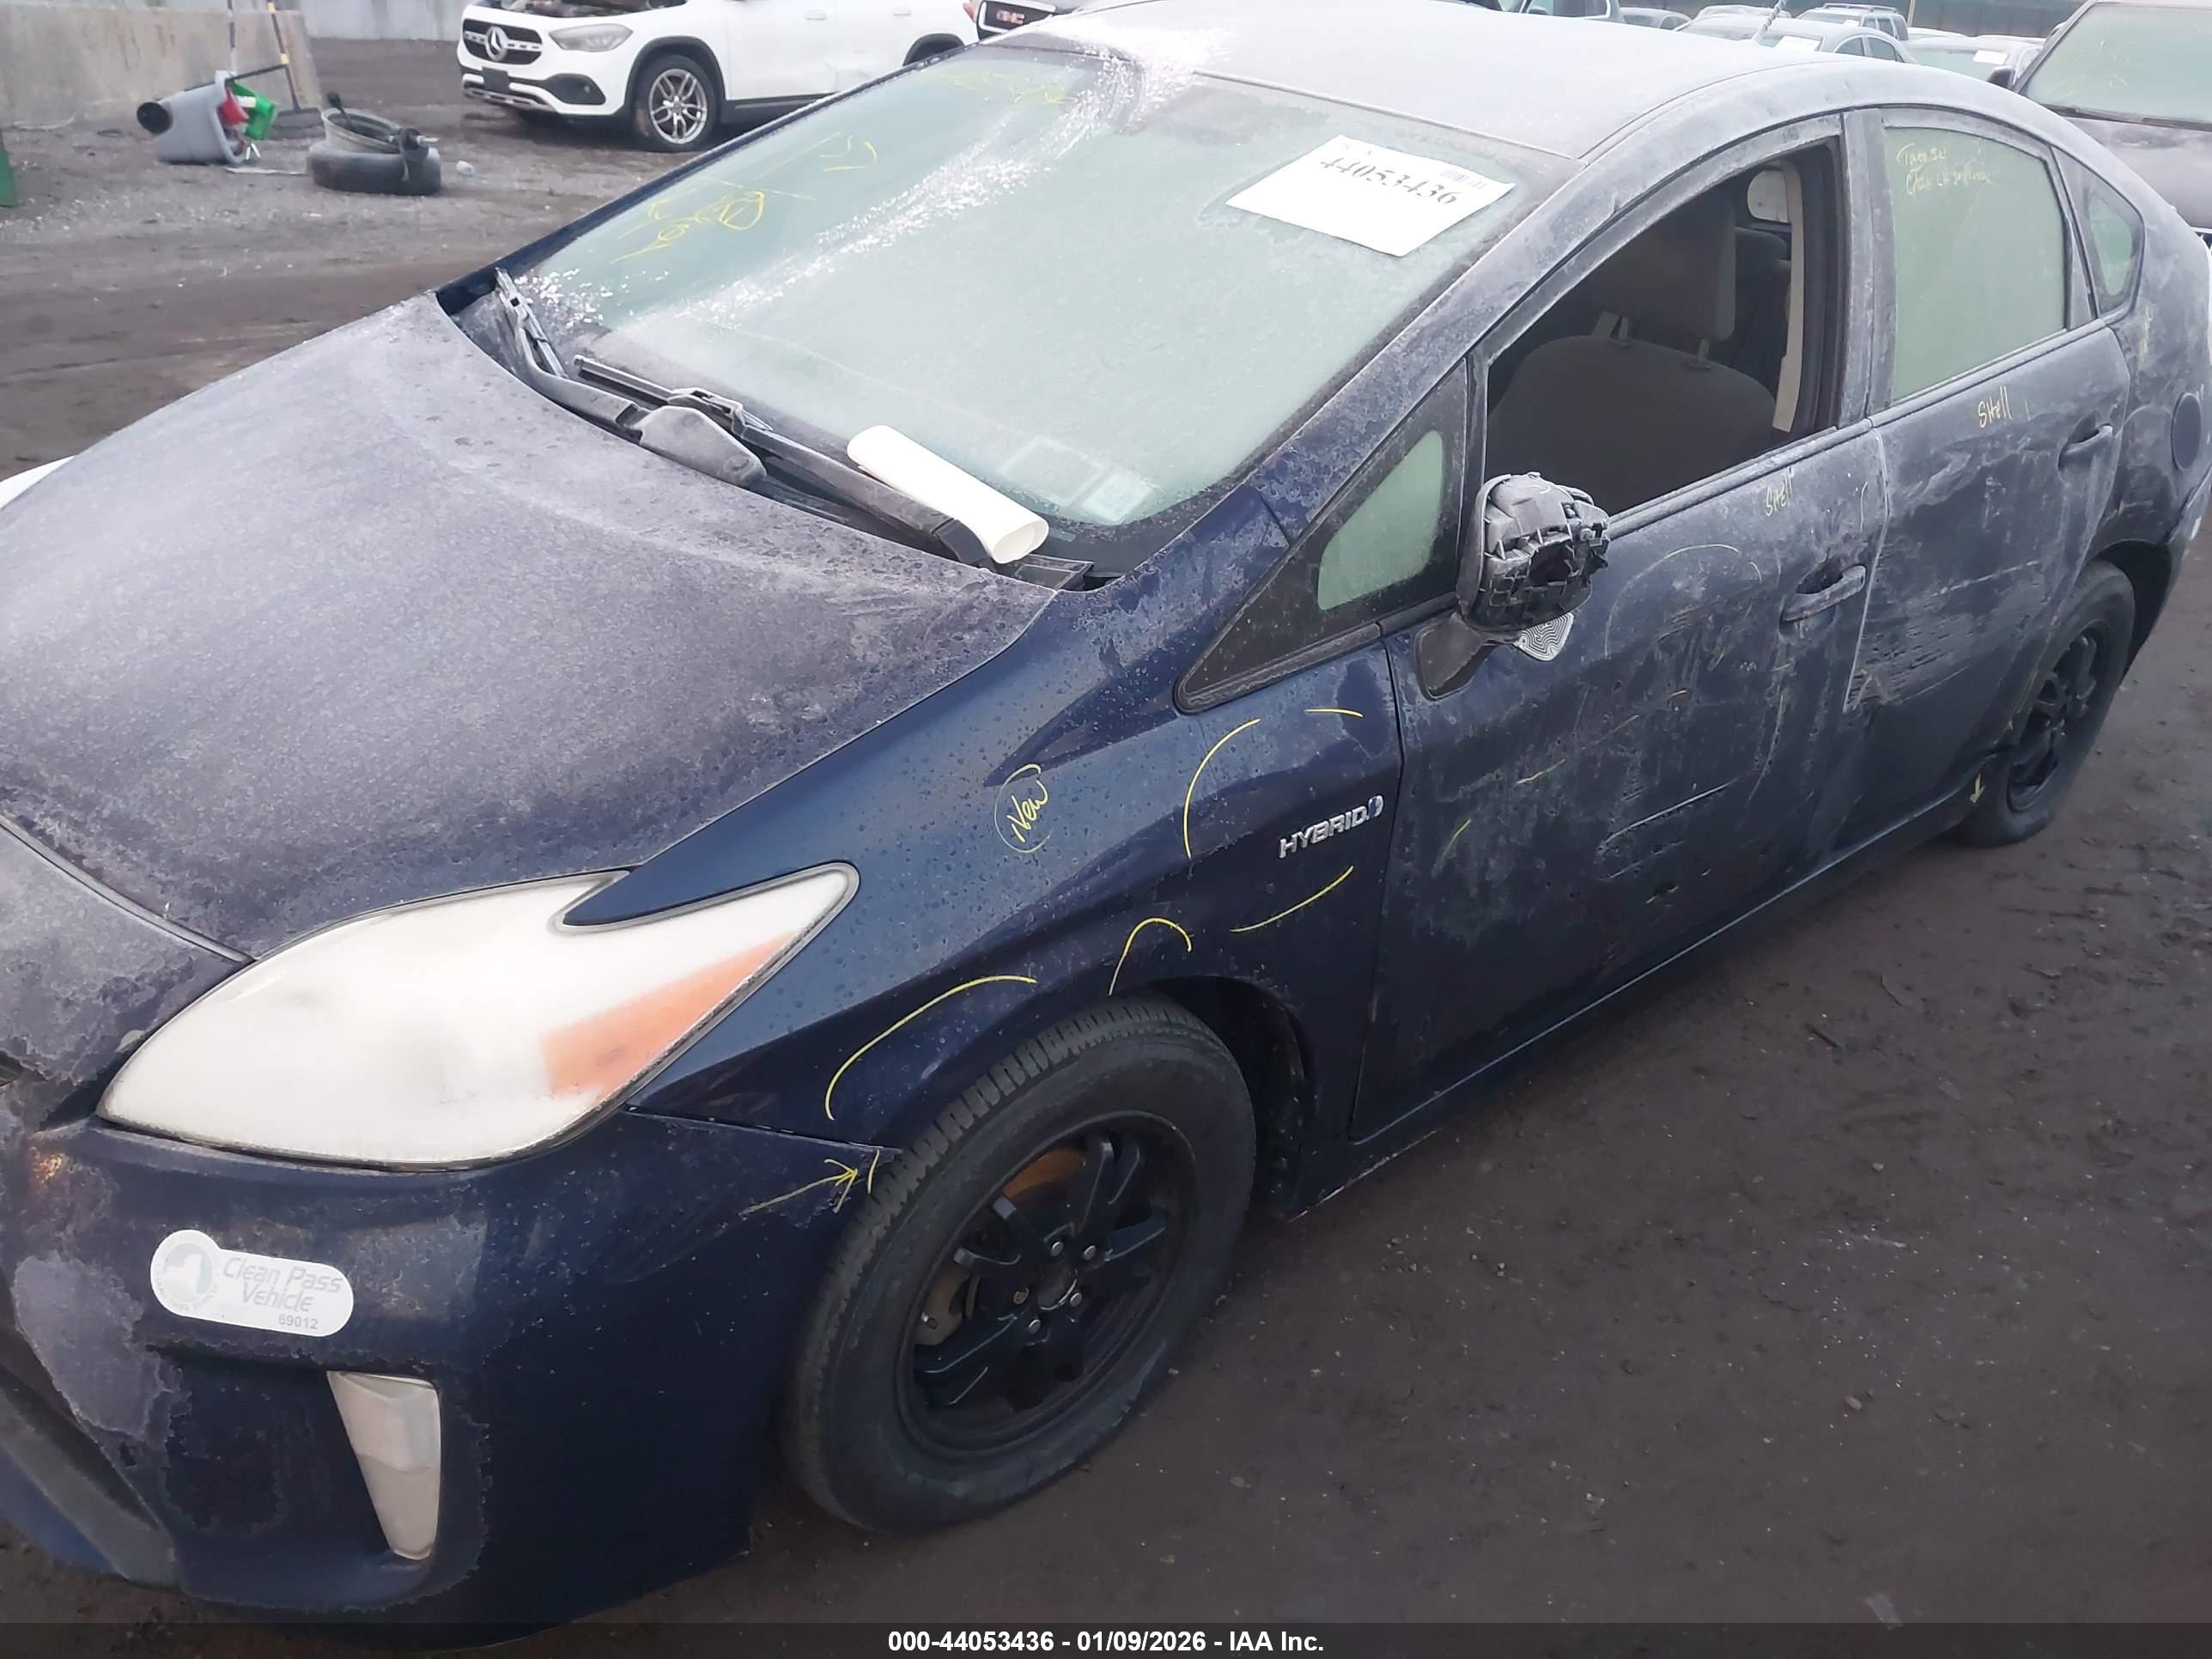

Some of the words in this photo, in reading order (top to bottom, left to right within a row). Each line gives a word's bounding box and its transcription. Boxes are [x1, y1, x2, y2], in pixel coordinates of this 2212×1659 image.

[1320, 157, 1462, 204] 44053436
[1006, 779, 1048, 843] New
[1279, 805, 1369, 859] HYBRID
[222, 1257, 282, 1285] Clean
[286, 1265, 343, 1293] Pass
[241, 1281, 314, 1312] Vehicle
[277, 1314, 319, 1330] 69012
